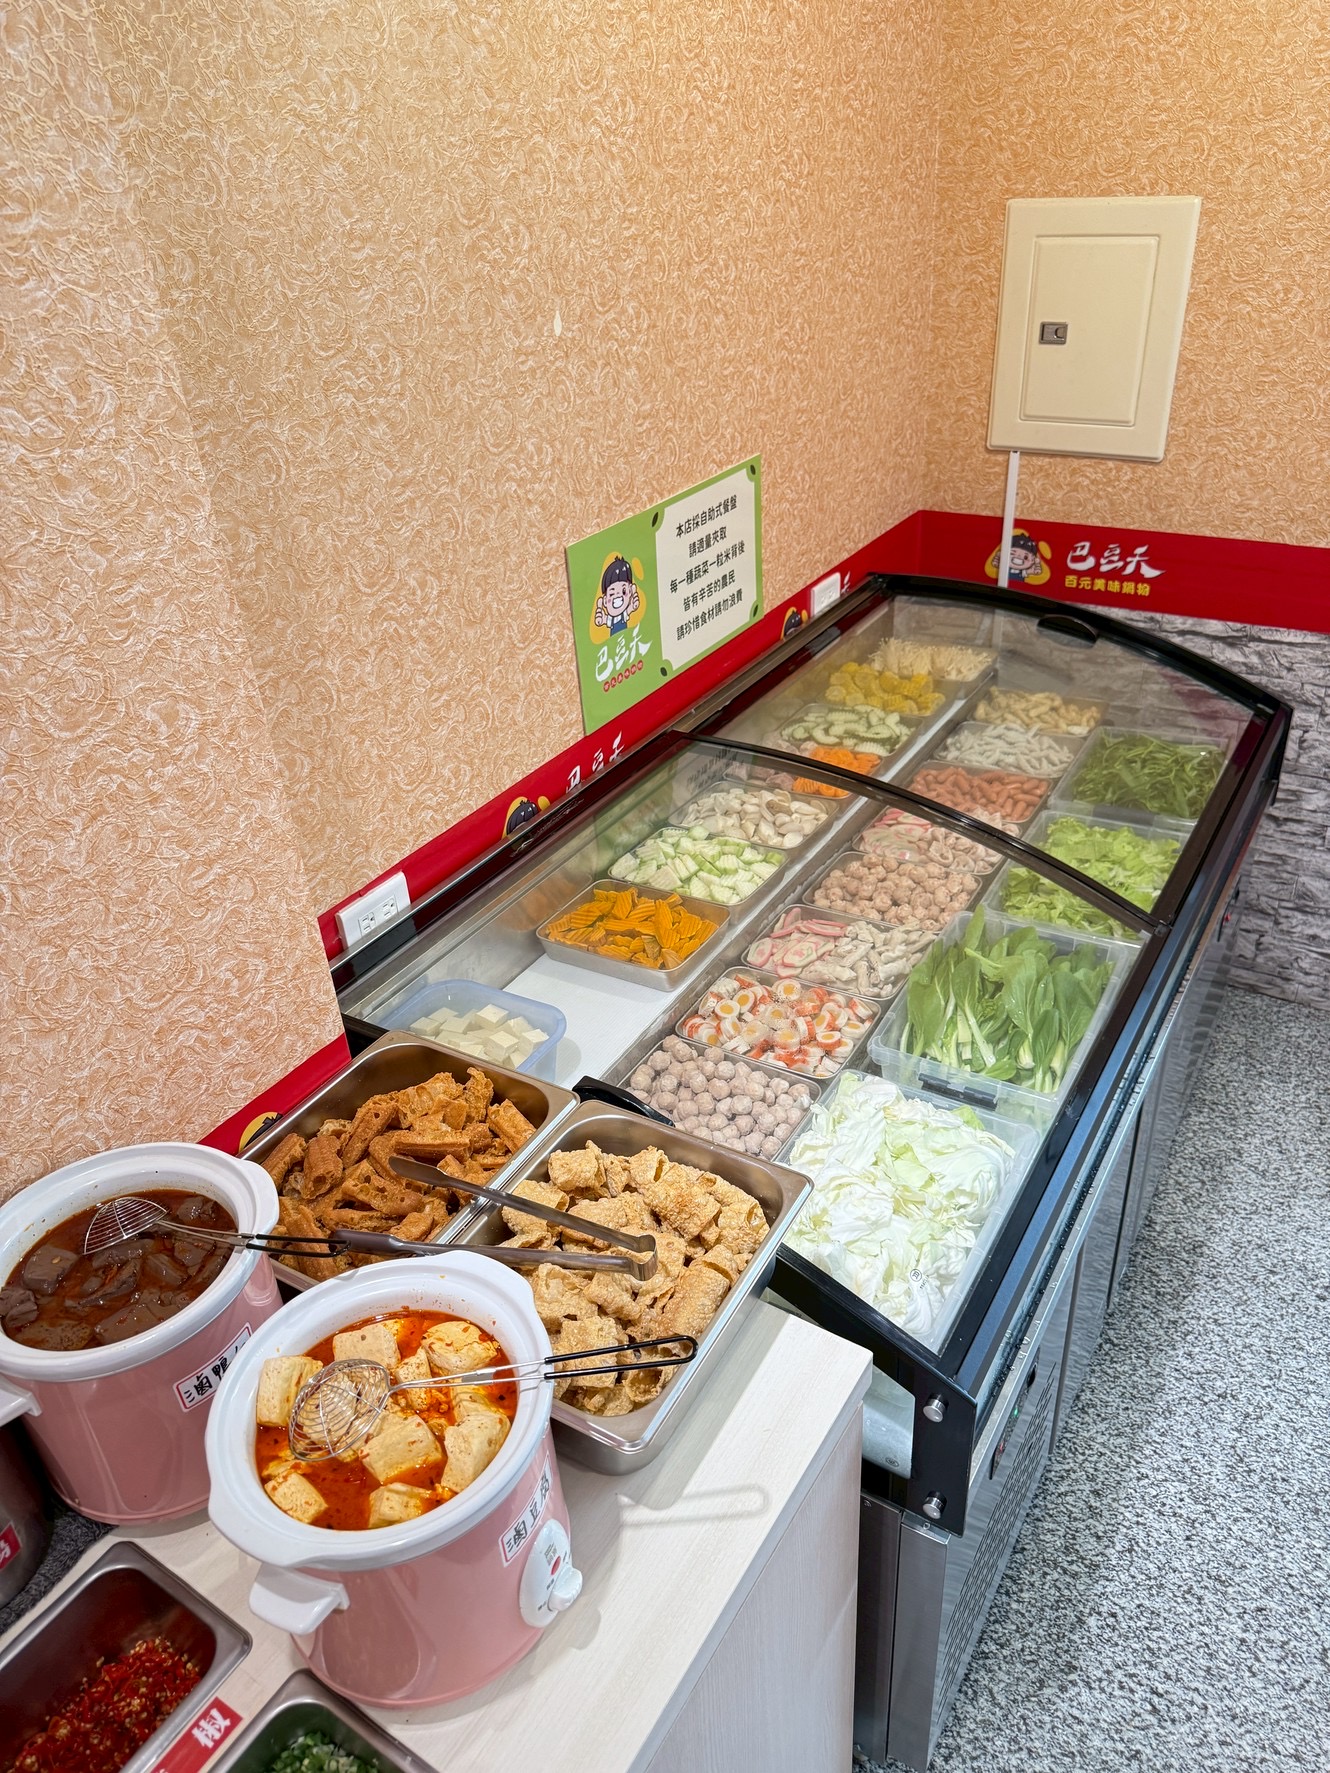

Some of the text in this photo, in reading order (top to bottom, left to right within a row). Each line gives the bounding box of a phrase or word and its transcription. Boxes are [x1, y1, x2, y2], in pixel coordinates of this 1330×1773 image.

[688, 526, 727, 558] 請適量夾取
[670, 540, 745, 594] 每一種蔬菜一粒米背後
[683, 569, 736, 613] 皆有辛苦的農民
[1064, 575, 1151, 597] 百元美味鍋物
[676, 588, 743, 641] 請珍惜食材請勿浪費
[184, 1341, 245, 1403] 滷鴨
